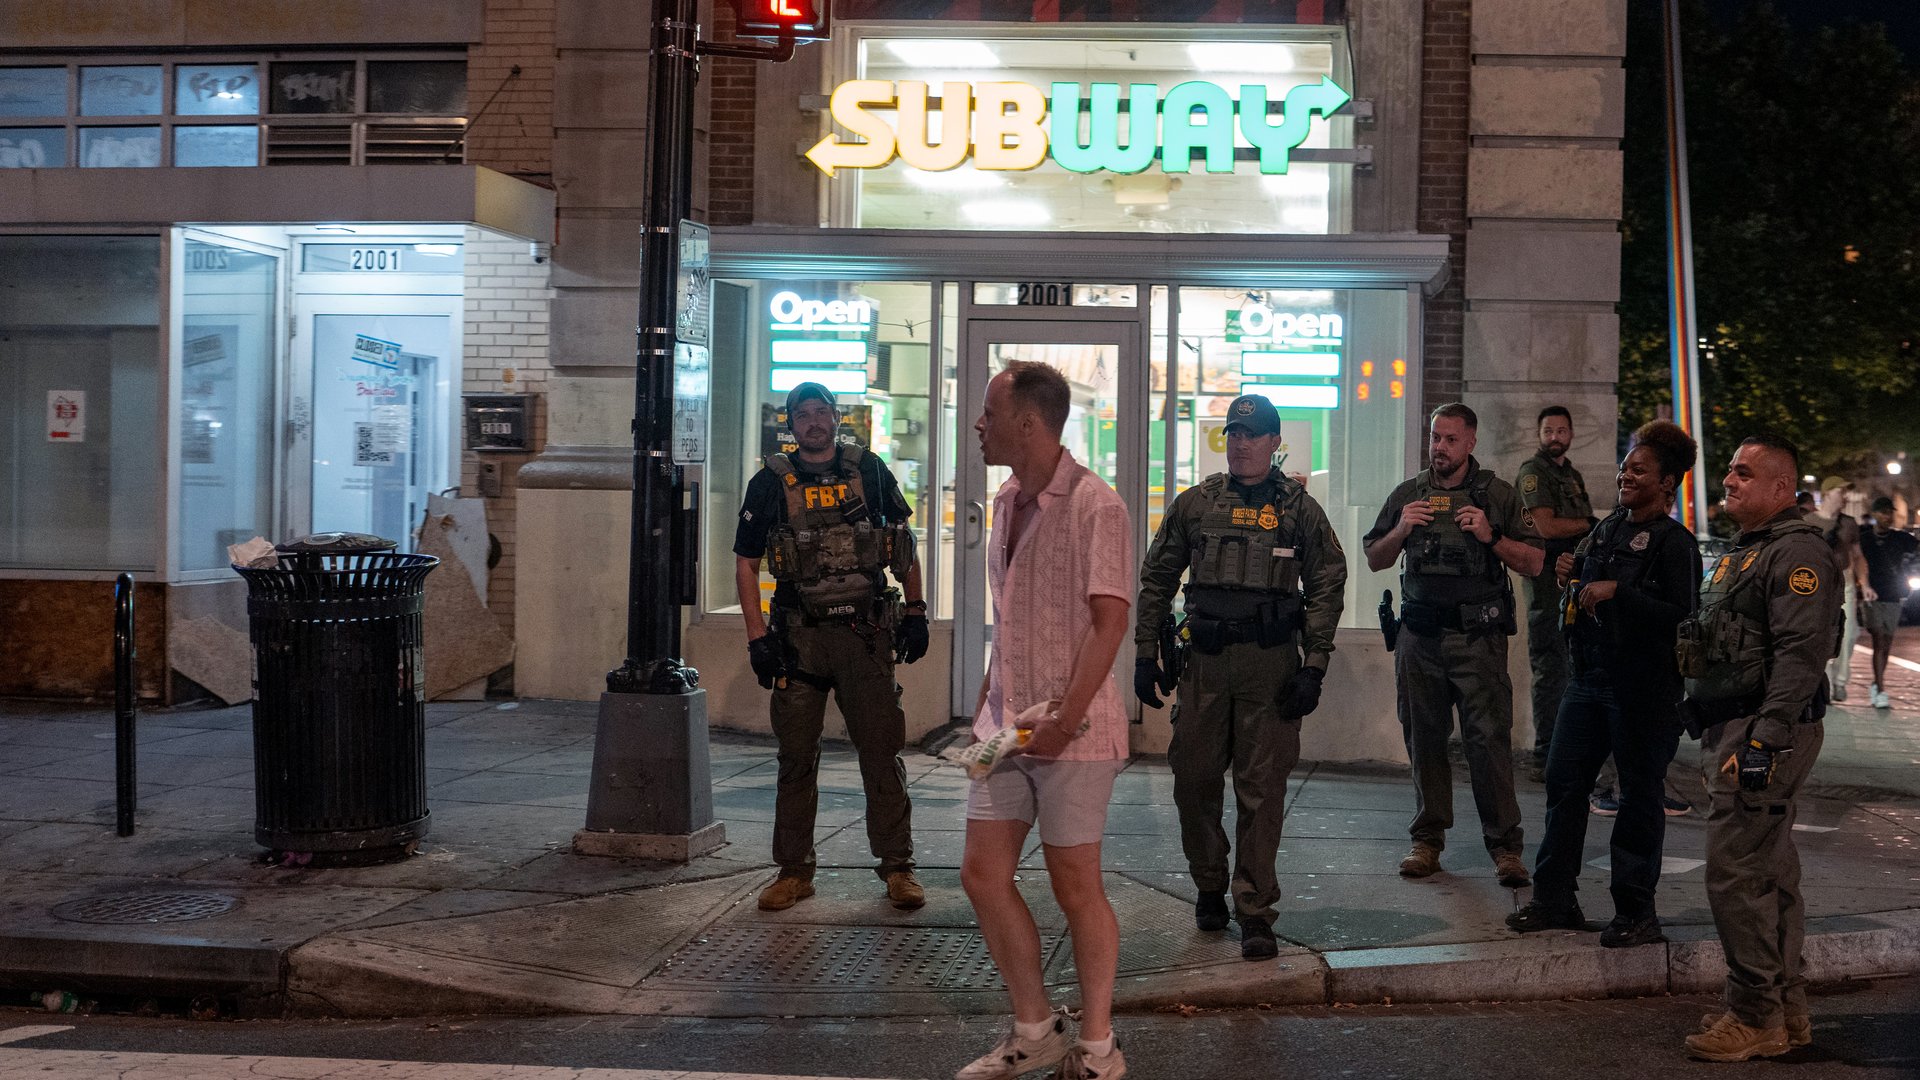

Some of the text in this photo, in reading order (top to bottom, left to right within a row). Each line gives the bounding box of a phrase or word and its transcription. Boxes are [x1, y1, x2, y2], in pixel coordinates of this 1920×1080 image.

[804, 74, 1351, 178] SUBWAY
[352, 249, 399, 271] 2001
[1018, 283, 1072, 306] 2001
[770, 291, 871, 331] Open
[1239, 304, 1343, 345] Open
[680, 399, 699, 412] YIELD
[481, 423, 512, 435] 2001
[686, 418, 694, 432] TO
[681, 438, 698, 453] PEDS
[805, 484, 848, 509] FBI
[827, 605, 856, 616] MED
